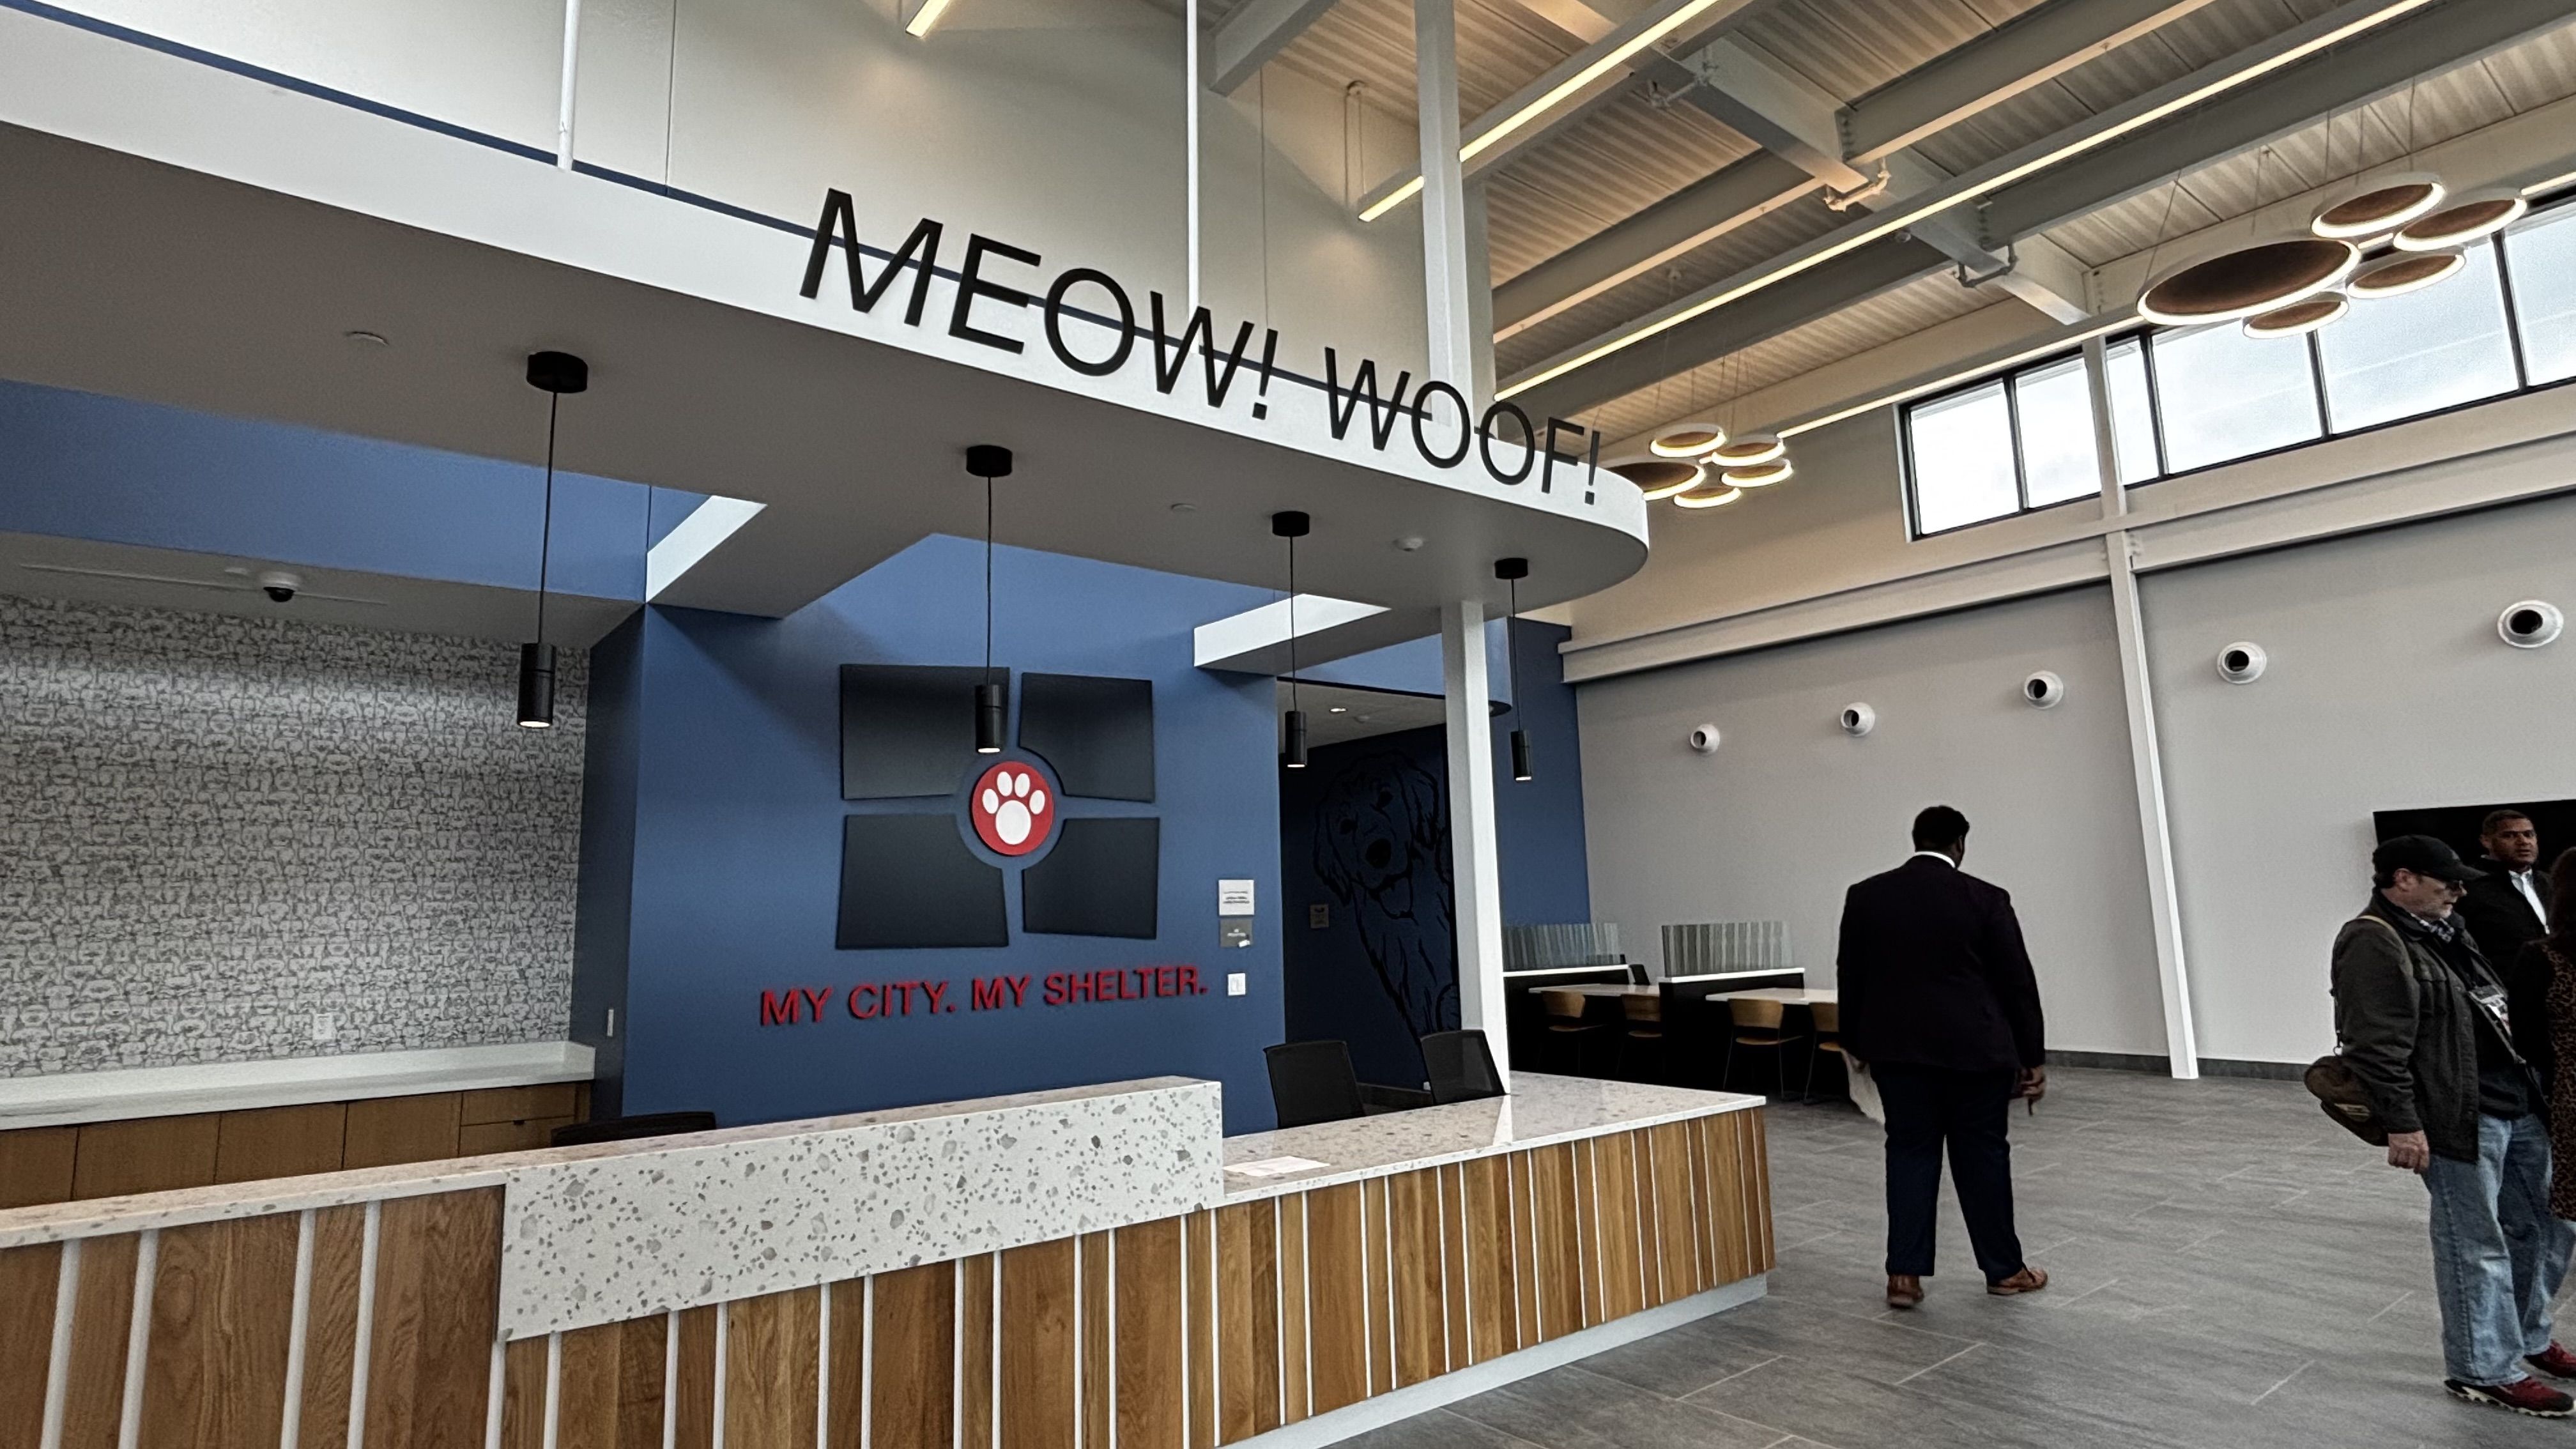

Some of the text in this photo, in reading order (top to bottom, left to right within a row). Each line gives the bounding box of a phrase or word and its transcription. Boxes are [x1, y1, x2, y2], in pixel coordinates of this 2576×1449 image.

[800, 188, 1600, 506] MEOW! WOOF!
[760, 965, 1209, 1025] MY CITY. MY SHELTER.
